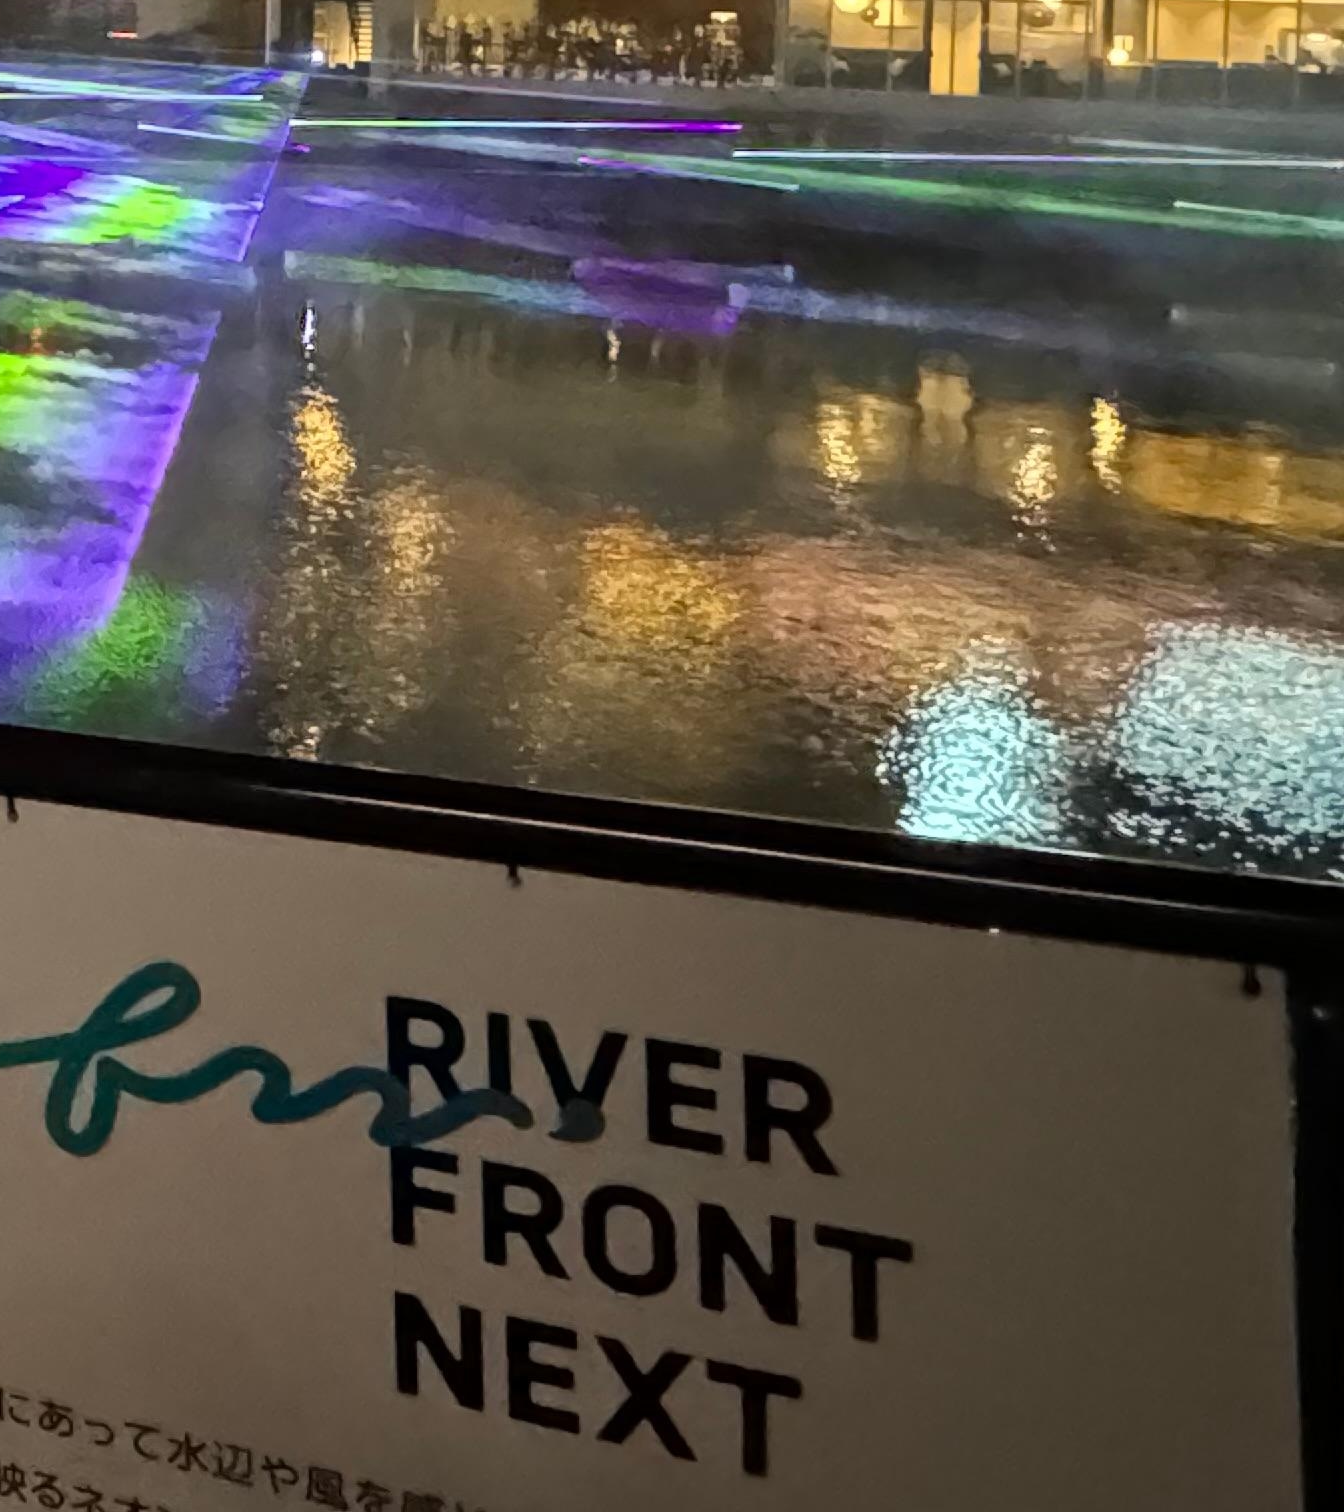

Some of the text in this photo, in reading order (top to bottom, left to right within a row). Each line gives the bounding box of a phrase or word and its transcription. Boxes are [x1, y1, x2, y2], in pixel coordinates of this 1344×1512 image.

[386, 994, 841, 1177] RIVER
[386, 1138, 914, 1343] FRONT
[392, 1290, 804, 1477] NEXT
